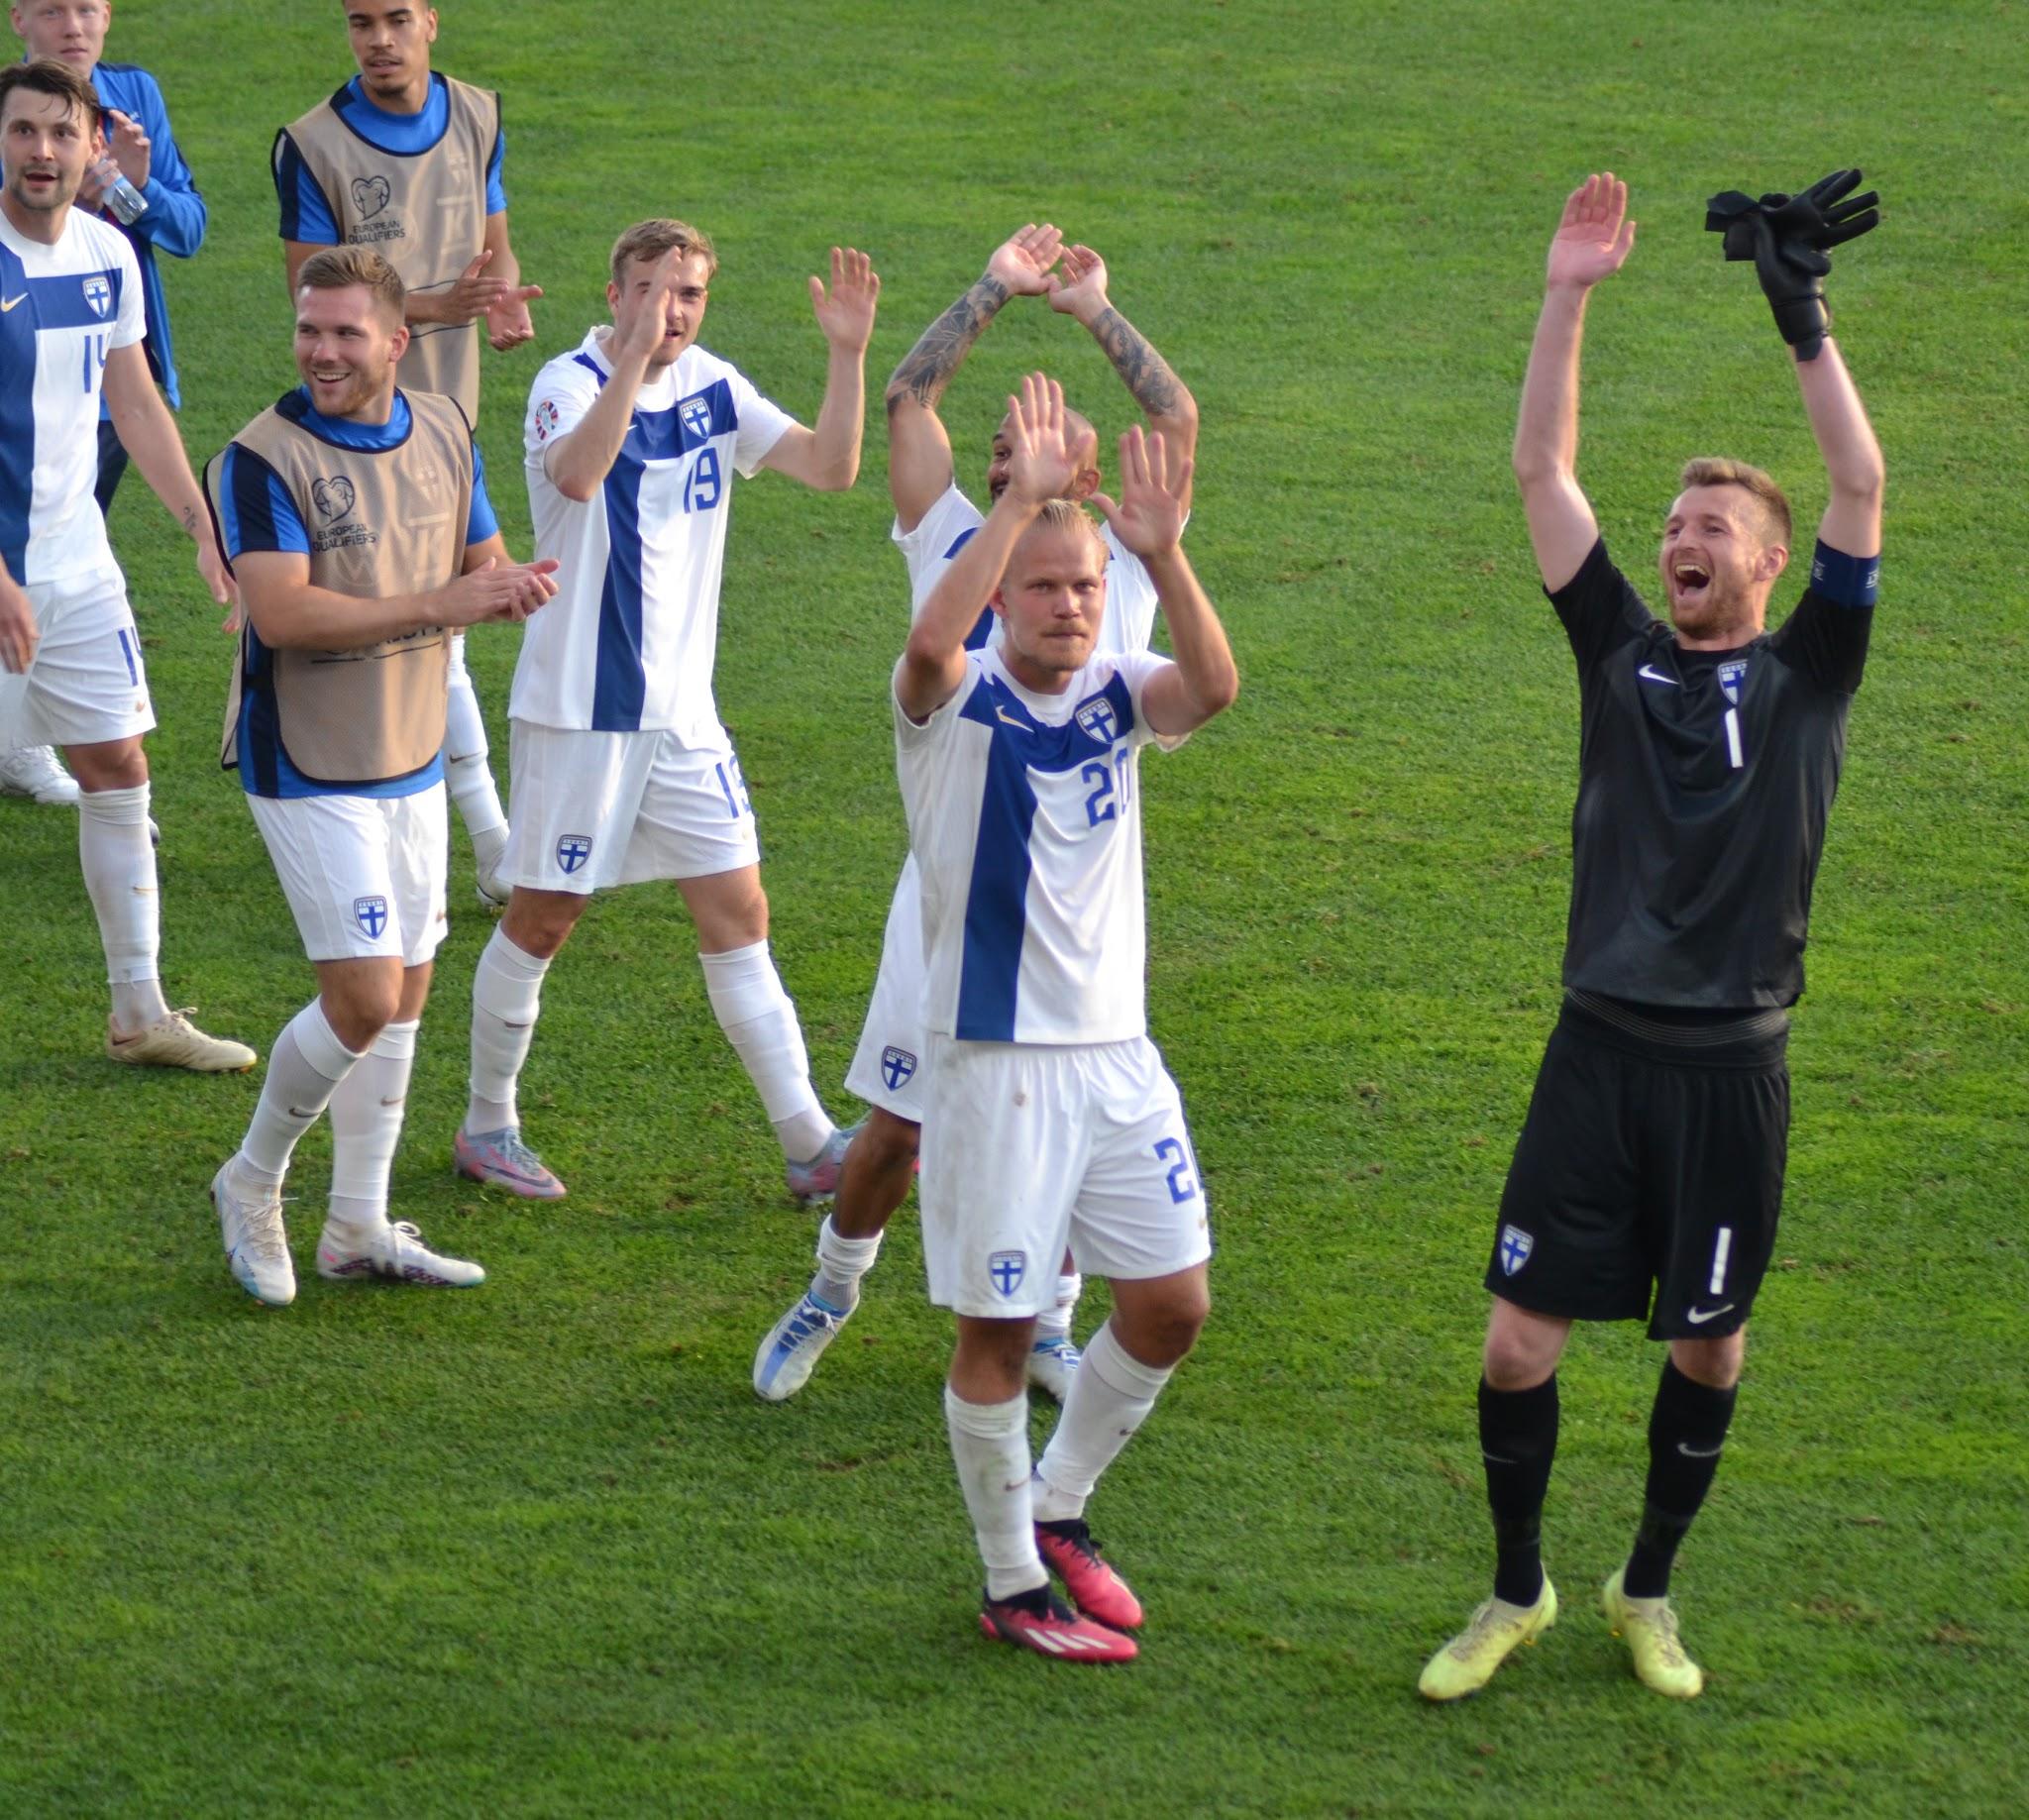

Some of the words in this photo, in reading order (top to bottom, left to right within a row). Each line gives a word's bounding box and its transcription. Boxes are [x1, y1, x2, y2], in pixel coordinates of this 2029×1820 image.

[348, 229, 406, 245] QUALIFIERS
[353, 220, 400, 234] EUROPEAN
[684, 447, 721, 514] 19
[1725, 707, 1744, 768] 1
[1153, 1136, 1201, 1205] 2
[1710, 1228, 1732, 1294] 1
